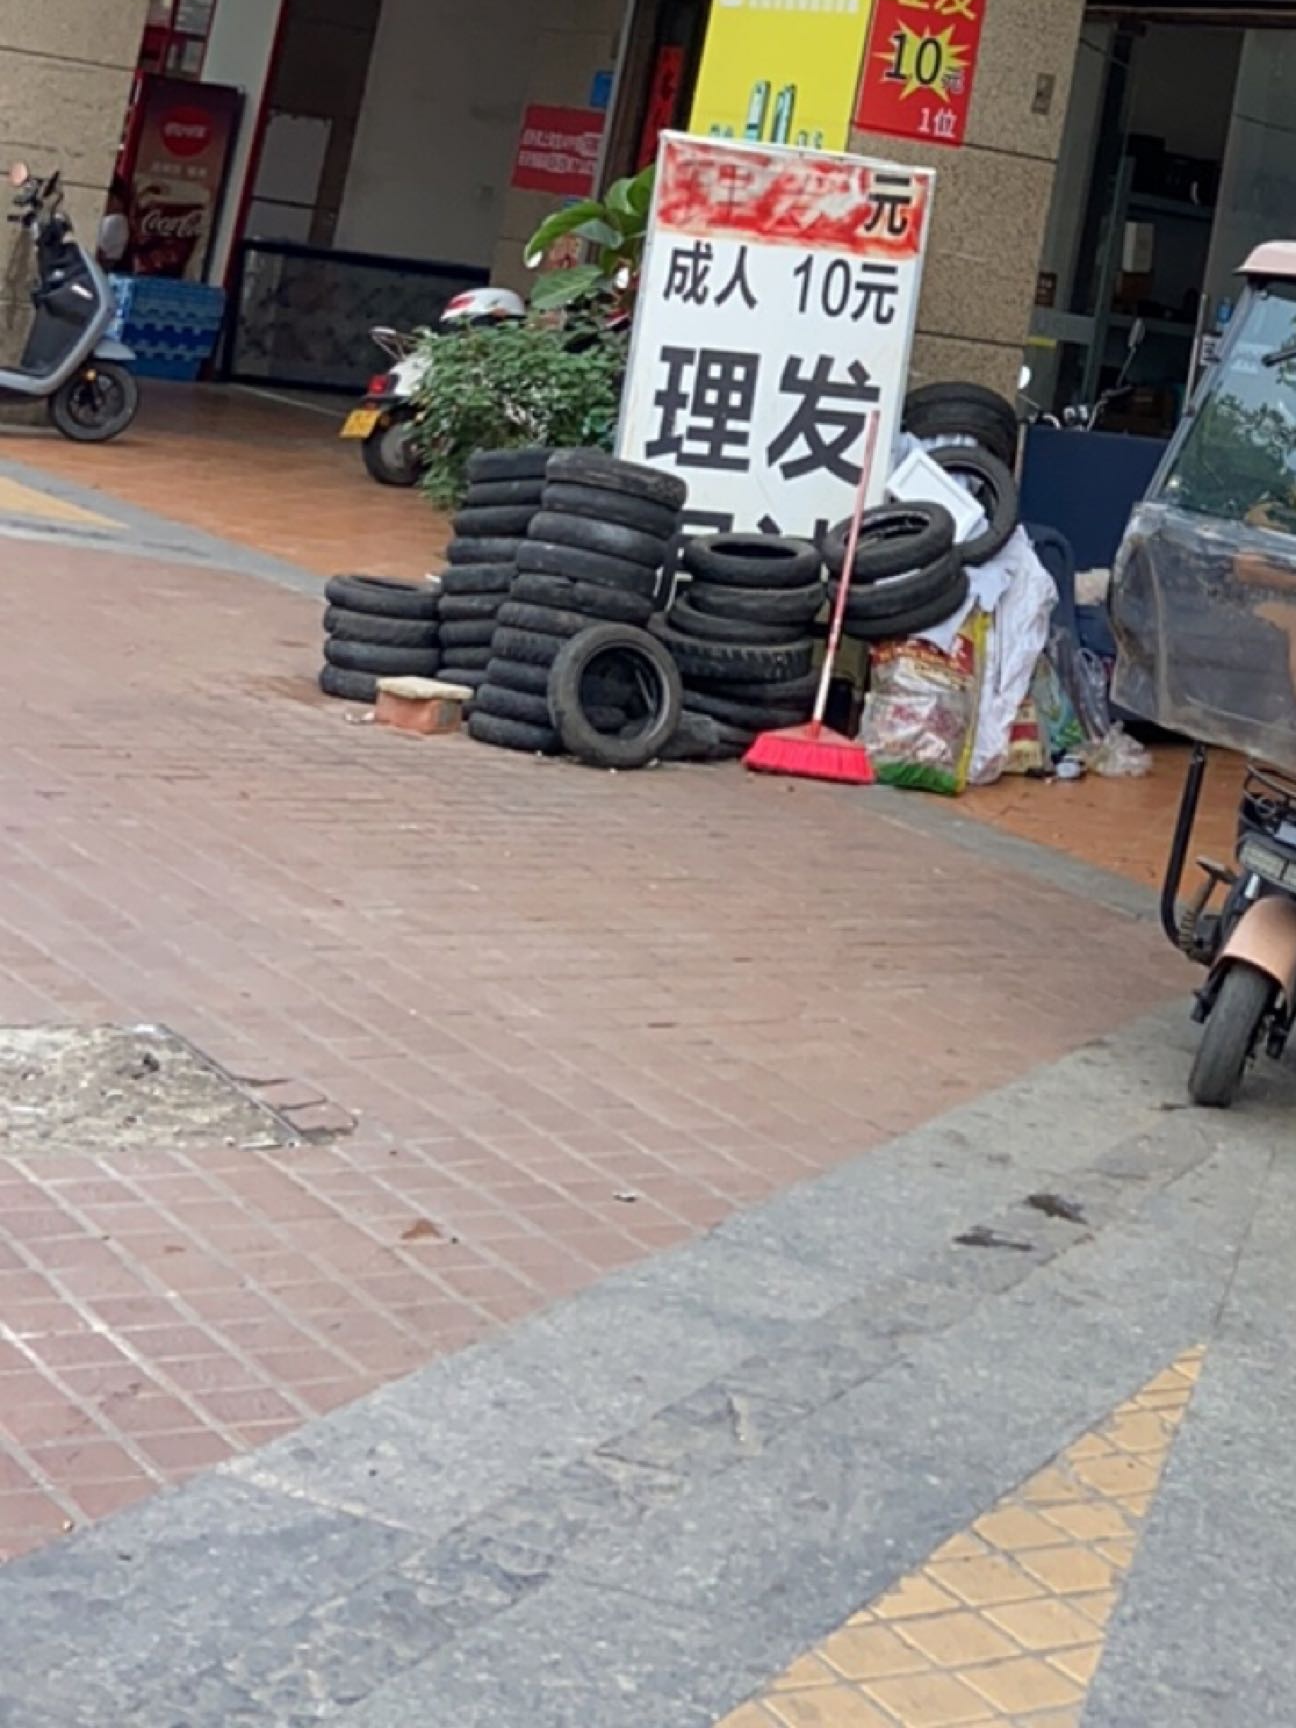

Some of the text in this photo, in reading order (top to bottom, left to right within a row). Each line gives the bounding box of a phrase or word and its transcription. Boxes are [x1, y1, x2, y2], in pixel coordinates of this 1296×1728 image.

[662, 240, 899, 325] 成人 10元
[645, 345, 880, 486] 理发
